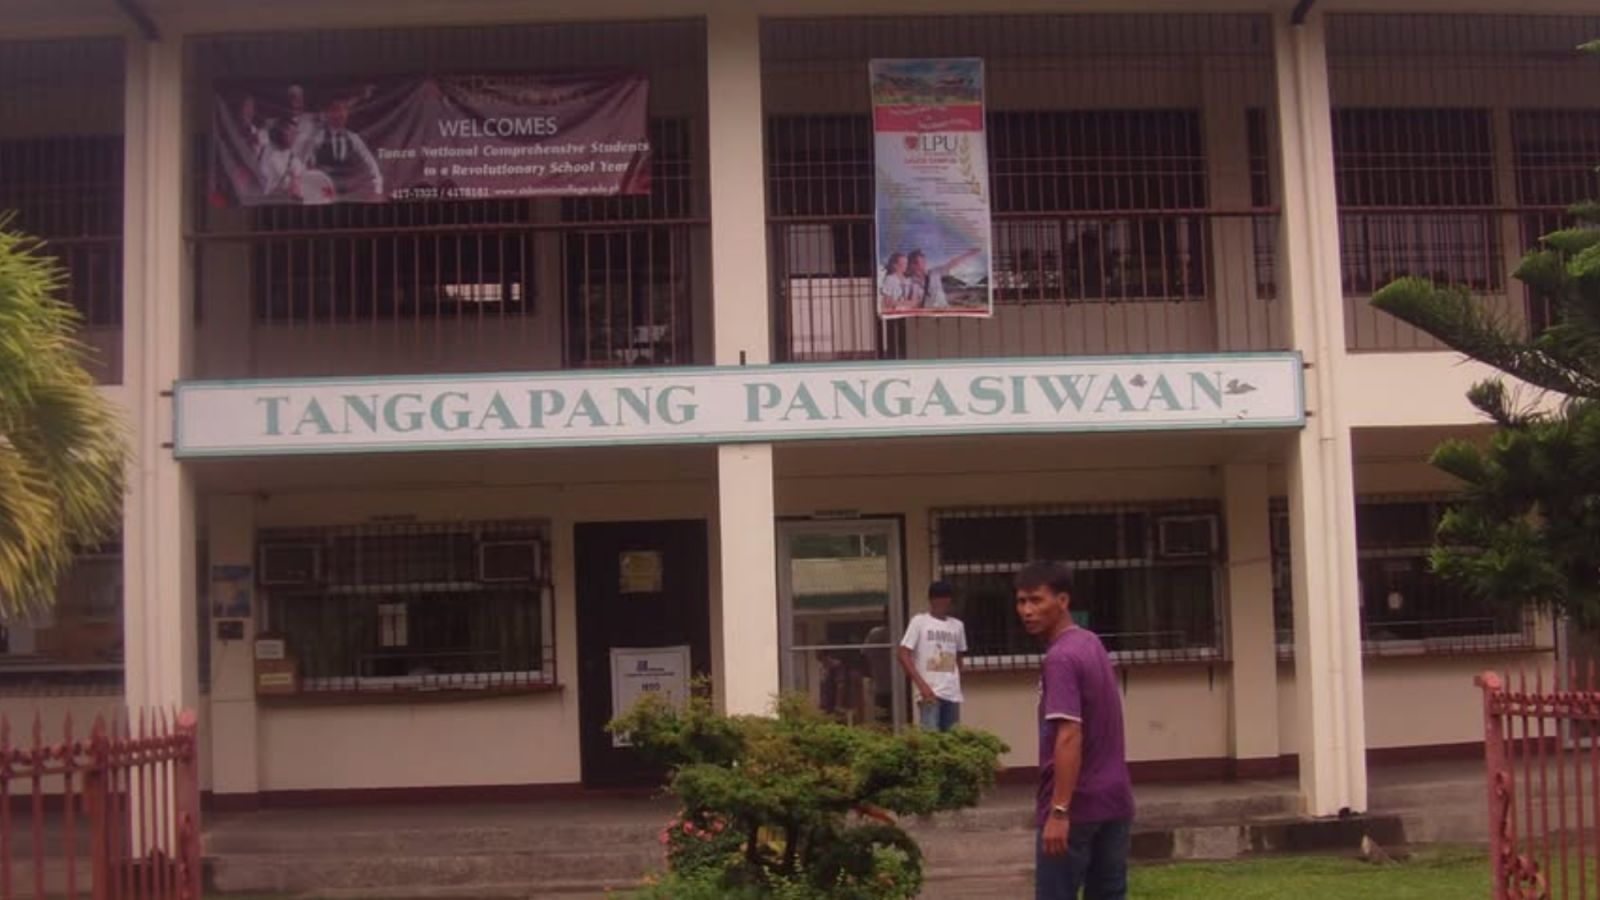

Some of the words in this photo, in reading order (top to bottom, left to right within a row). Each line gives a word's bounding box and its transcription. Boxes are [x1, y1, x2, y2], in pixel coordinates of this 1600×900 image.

[438, 116, 558, 138] WELCOMES
[377, 147, 416, 160] Tanza
[422, 145, 478, 158] National
[483, 143, 586, 158] Comprehensive
[590, 140, 650, 154] Students
[922, 134, 959, 152] LPU
[423, 166, 437, 177] to
[451, 162, 545, 177] Revolutionary
[549, 160, 595, 174] School
[257, 385, 698, 436] TANGGAPANG
[743, 370, 1224, 423] PANGASIWAAN
